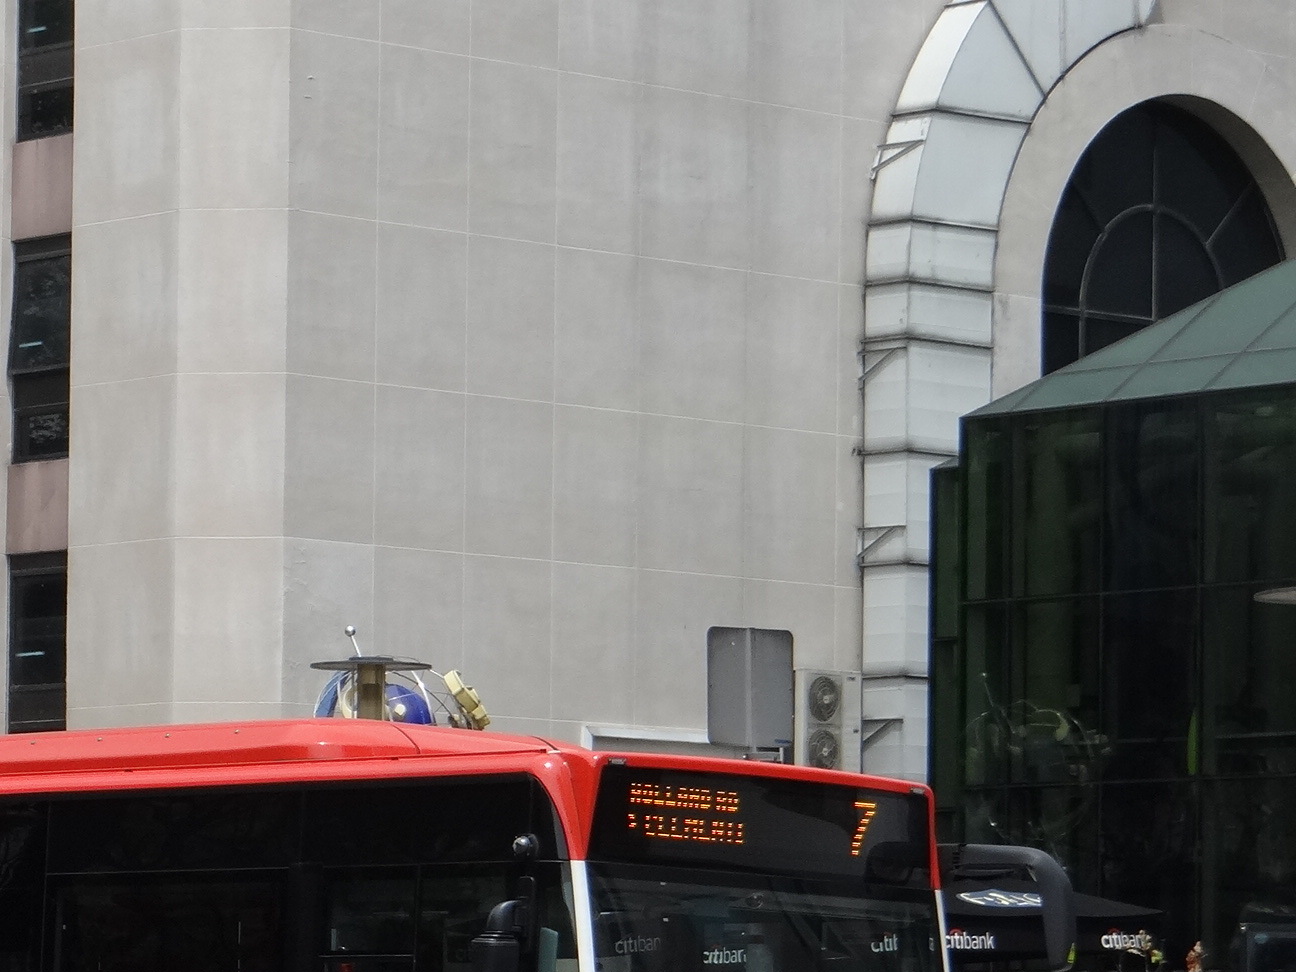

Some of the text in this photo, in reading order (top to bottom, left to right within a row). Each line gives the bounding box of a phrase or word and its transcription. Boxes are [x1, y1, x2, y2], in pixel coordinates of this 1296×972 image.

[852, 801, 876, 855] 7
[1101, 932, 1145, 949] citiban
[703, 947, 746, 964] citiban
